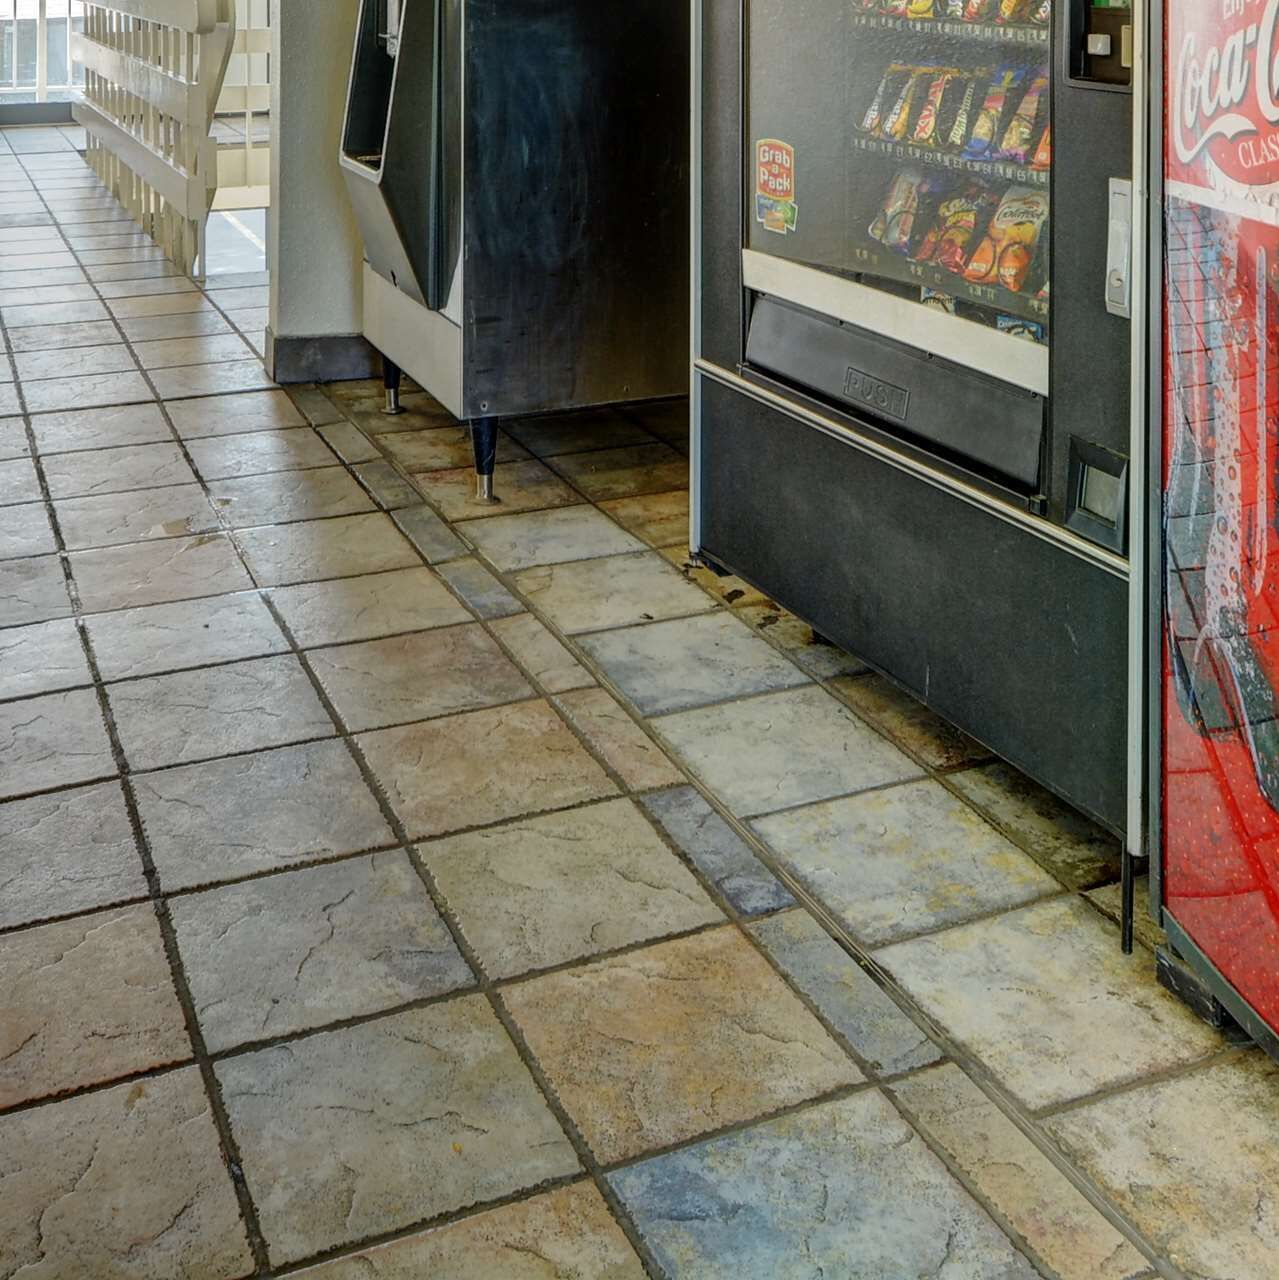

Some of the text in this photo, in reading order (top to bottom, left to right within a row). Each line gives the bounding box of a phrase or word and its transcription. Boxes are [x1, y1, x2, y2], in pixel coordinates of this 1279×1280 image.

[760, 145, 791, 169] Grab
[771, 163, 779, 174] a
[760, 166, 791, 192] Pack
